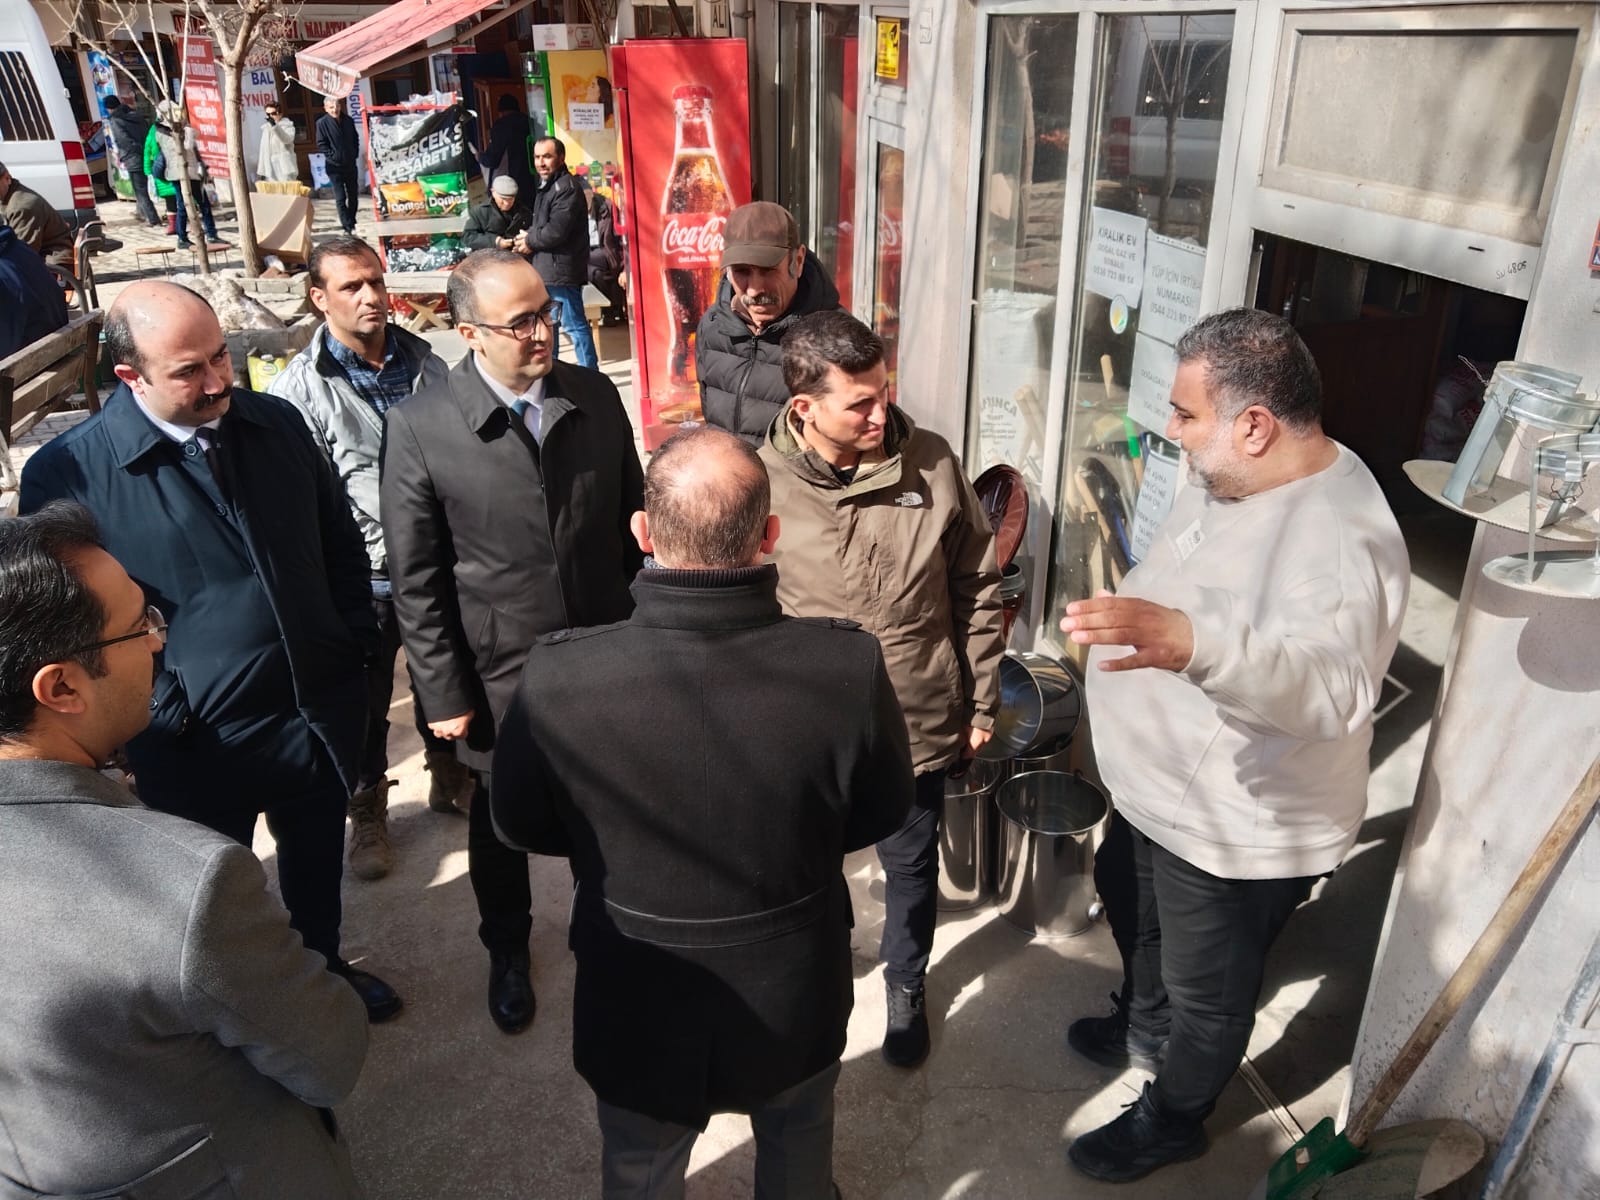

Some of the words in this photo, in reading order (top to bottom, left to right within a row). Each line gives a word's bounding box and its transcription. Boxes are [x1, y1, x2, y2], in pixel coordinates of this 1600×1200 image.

[251, 70, 275, 86] BAL
[391, 201, 425, 213] Doritos
[429, 195, 468, 208] Doritos
[1126, 234, 1137, 246] EV
